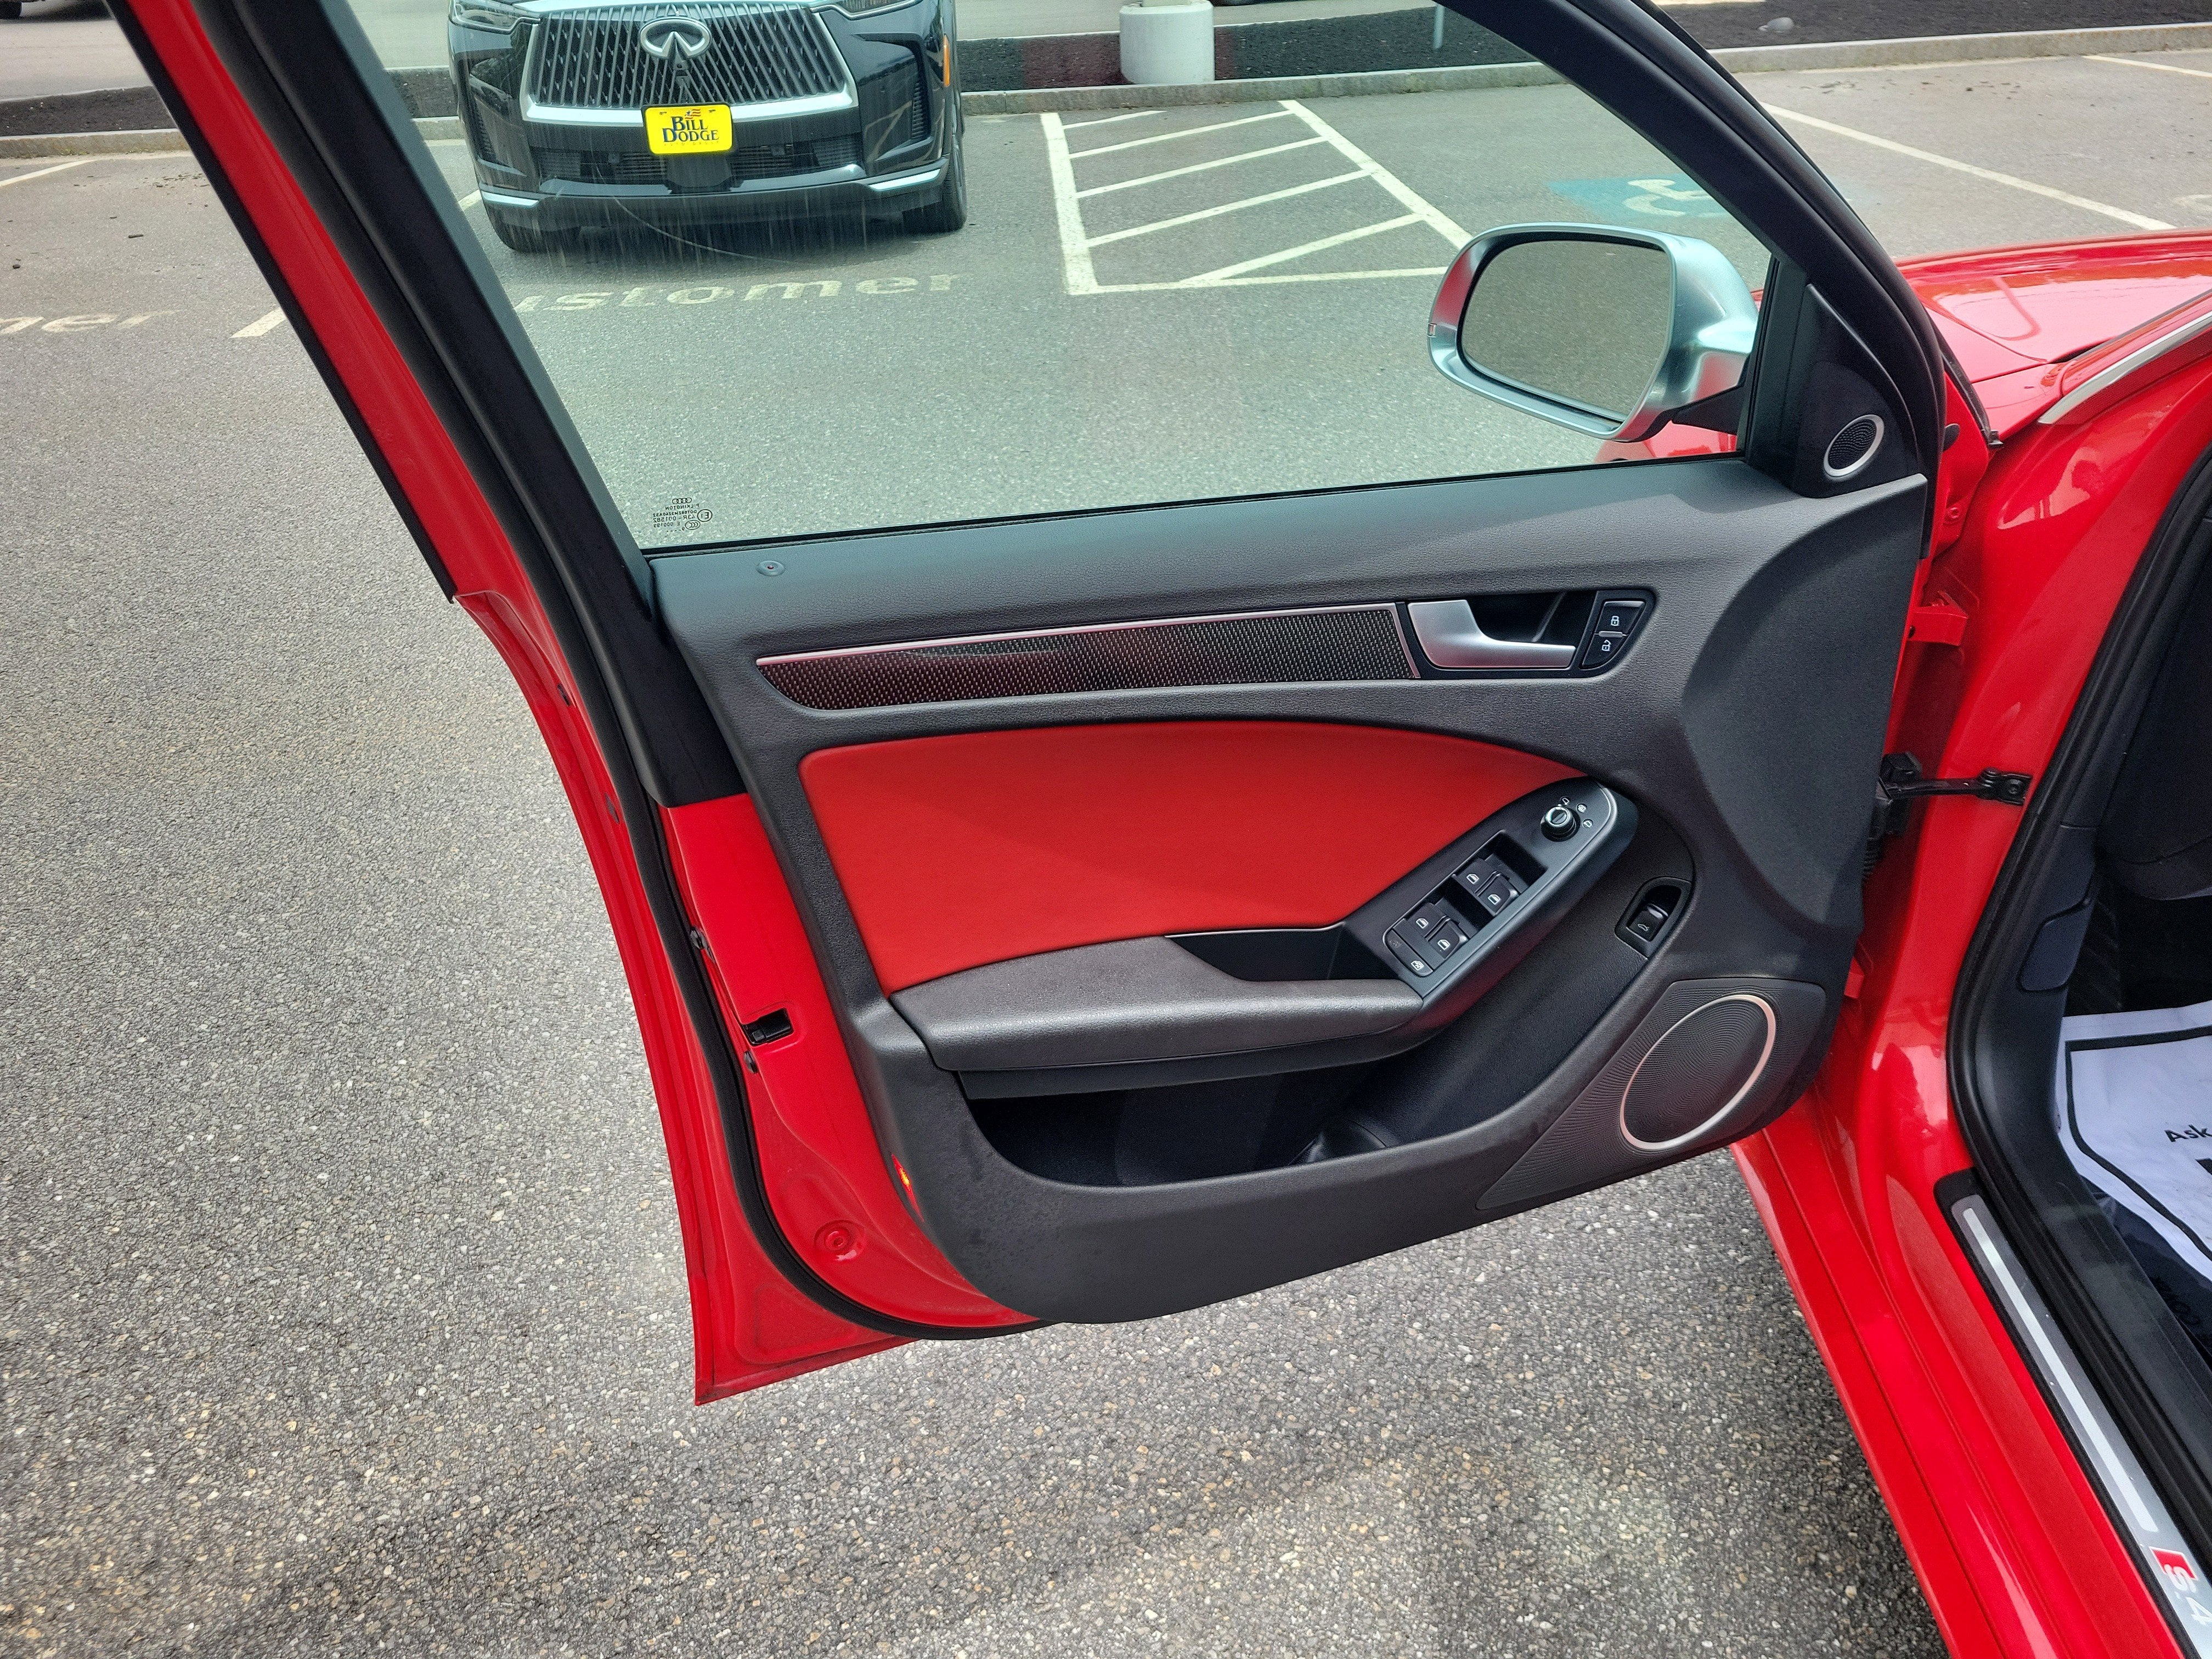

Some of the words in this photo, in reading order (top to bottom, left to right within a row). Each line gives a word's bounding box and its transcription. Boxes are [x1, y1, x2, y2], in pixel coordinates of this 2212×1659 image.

[671, 116, 708, 131] BILL
[662, 128, 719, 143] DODGE
[2164, 1124, 2212, 1142] Ask
